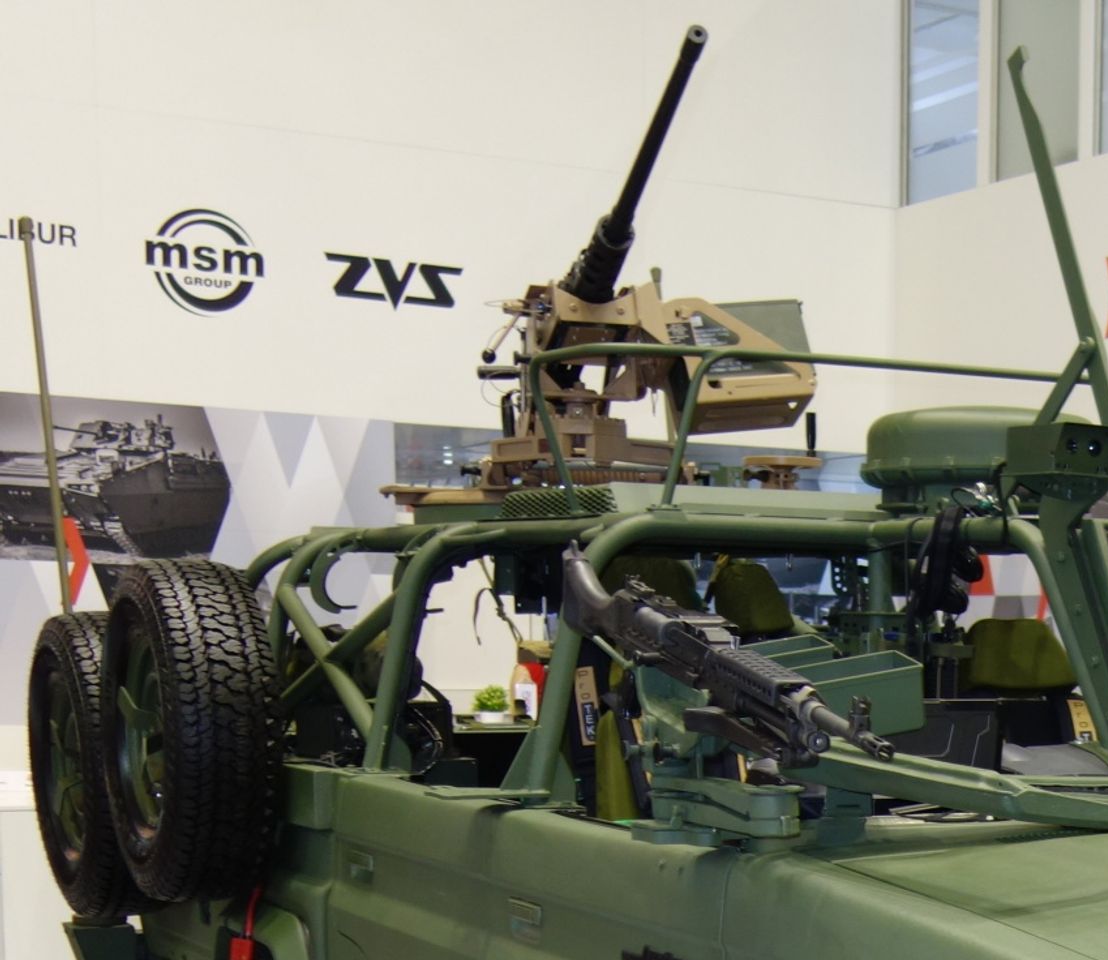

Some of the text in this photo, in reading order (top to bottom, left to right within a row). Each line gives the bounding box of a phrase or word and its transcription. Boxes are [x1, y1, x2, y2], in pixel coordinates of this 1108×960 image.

[145, 239, 264, 278] msm
[183, 276, 232, 289] GROUP
[323, 251, 463, 311] ZVS
